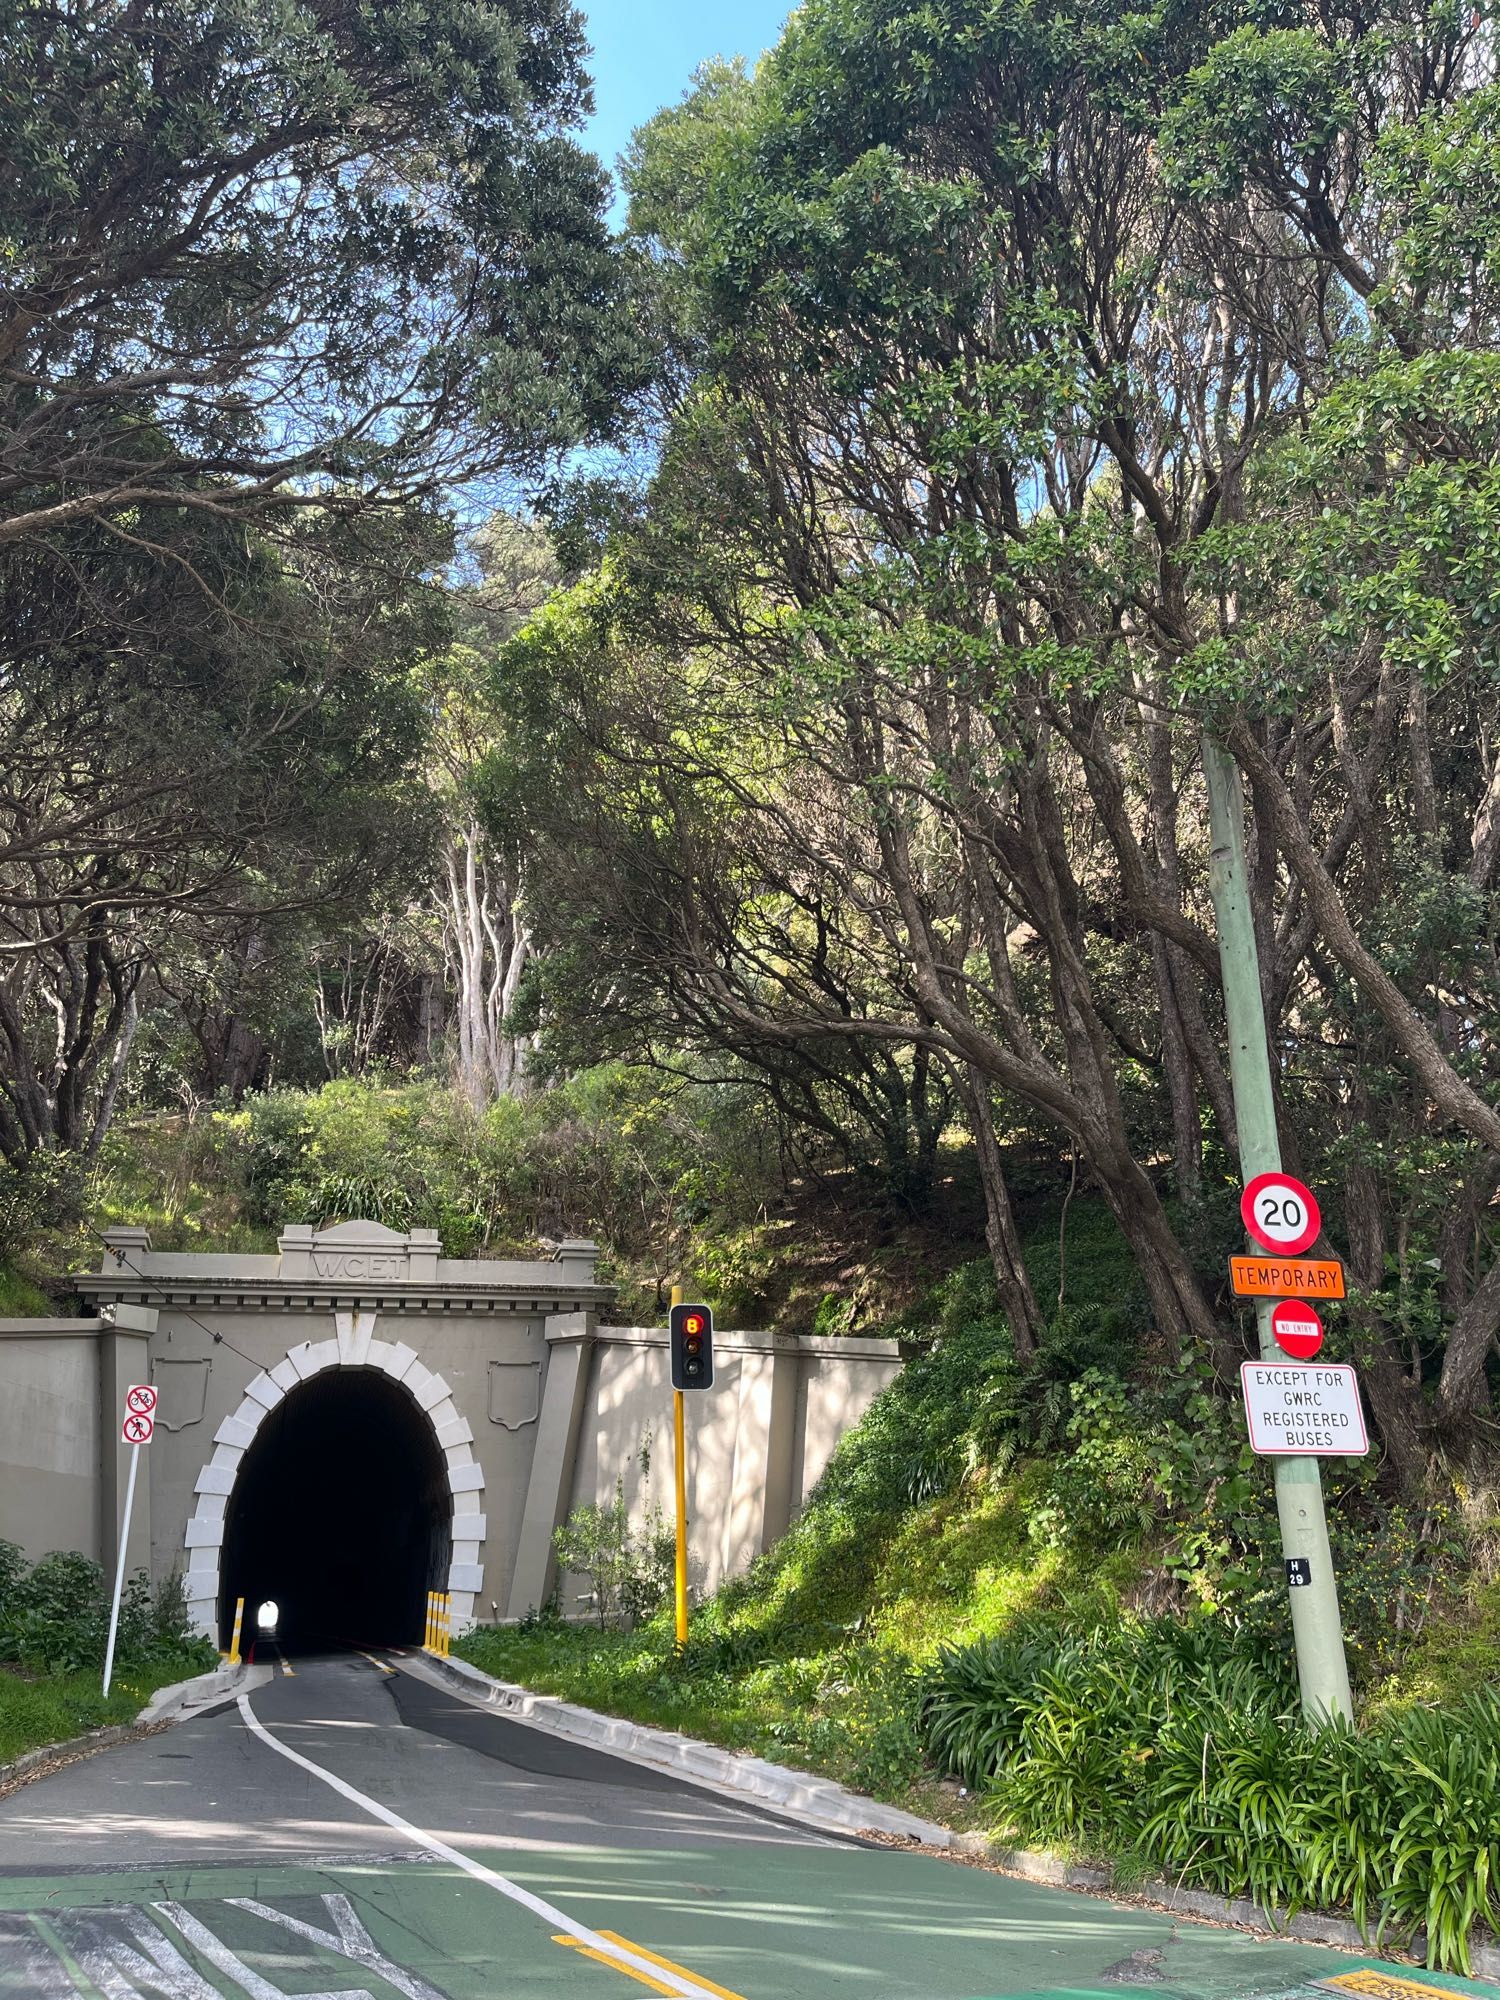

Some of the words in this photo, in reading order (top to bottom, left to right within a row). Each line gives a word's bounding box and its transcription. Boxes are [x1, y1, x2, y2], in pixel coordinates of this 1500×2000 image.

[1261, 1198, 1301, 1228] 20
[1236, 1266, 1338, 1289] TEMPORARY
[1281, 1323, 1290, 1332] NO
[1293, 1324, 1312, 1333] ENTRY
[1256, 1371, 1307, 1386] EXCEPT
[1316, 1372, 1343, 1387] FOR
[1284, 1391, 1322, 1406] GWRC
[1263, 1412, 1349, 1427] REGISTERED
[1286, 1431, 1333, 1446] BUSES
[1291, 1560, 1299, 1571] H
[1290, 1574, 1304, 1584] 29
